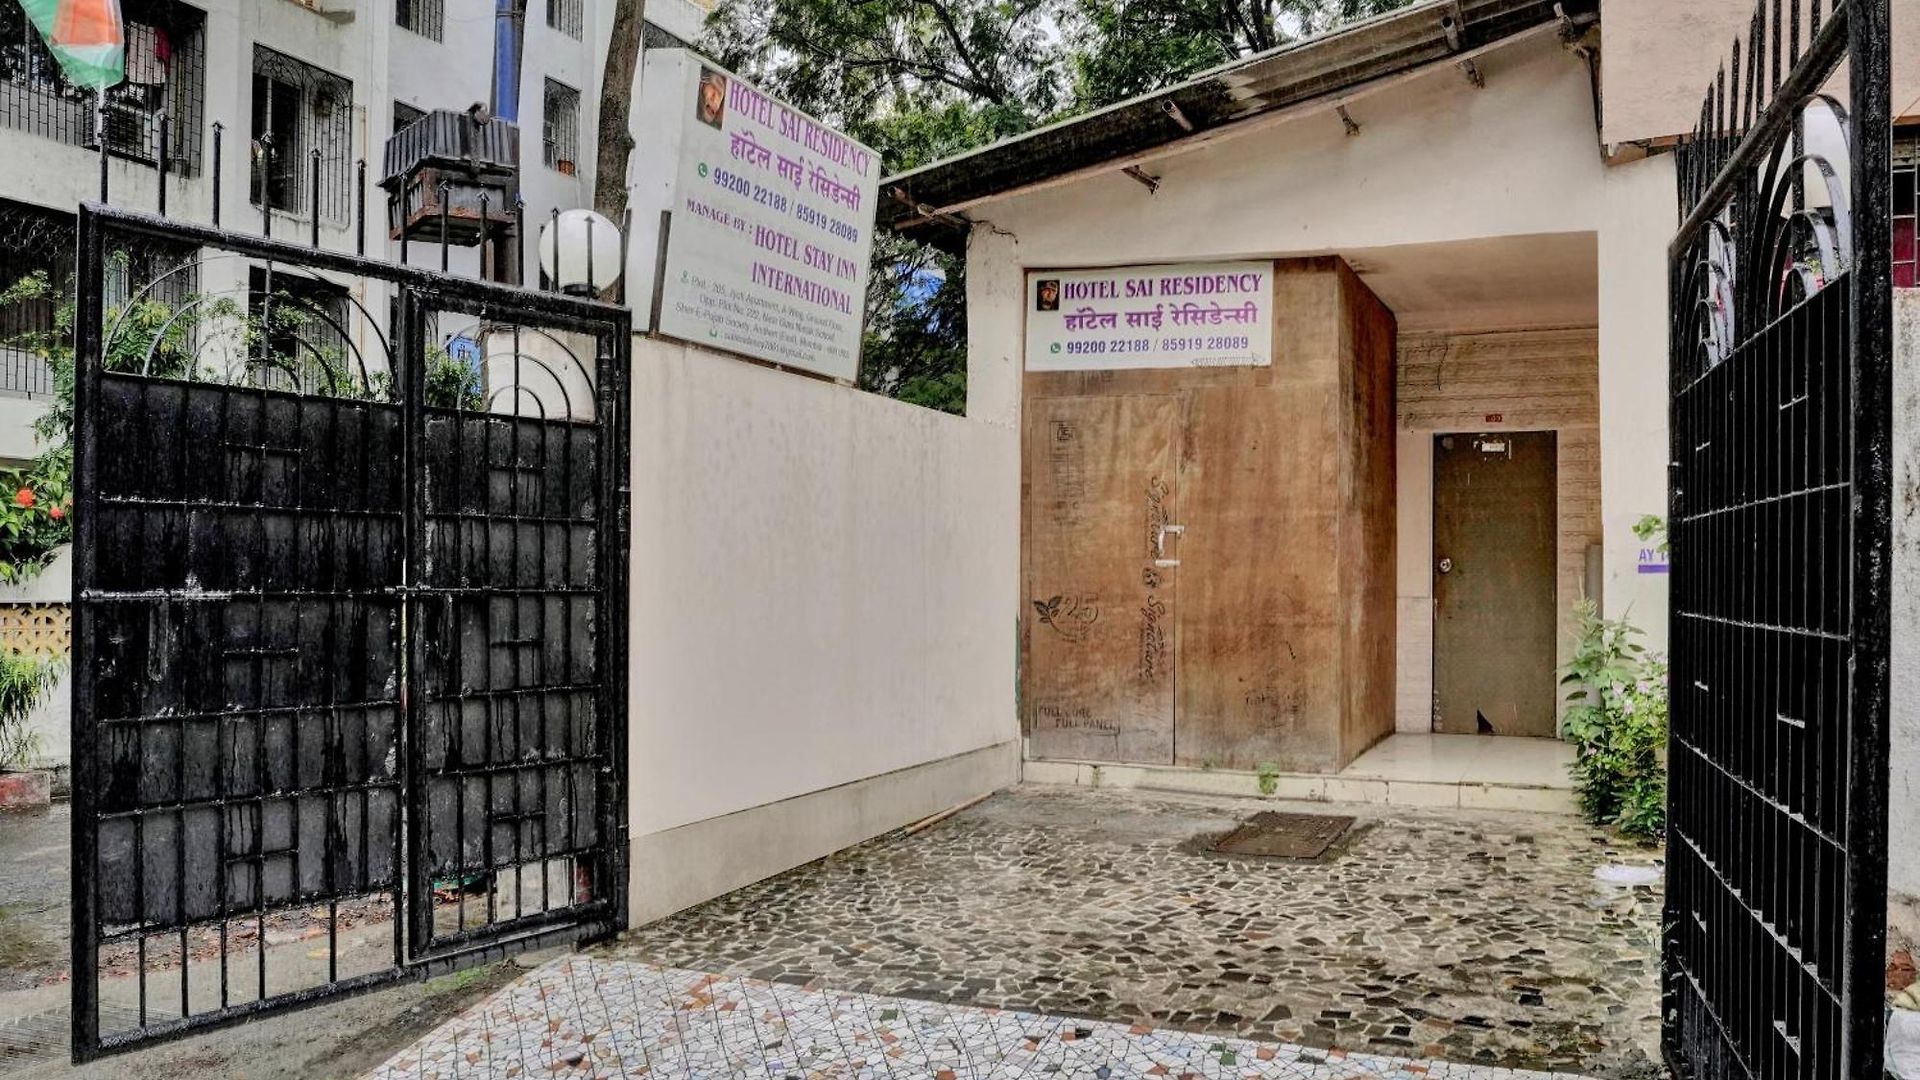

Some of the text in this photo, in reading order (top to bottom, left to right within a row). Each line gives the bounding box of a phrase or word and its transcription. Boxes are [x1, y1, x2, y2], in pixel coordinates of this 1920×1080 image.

[729, 80, 872, 178] HOTEL SAI RESIDENCY
[714, 167, 750, 198] 99200
[753, 185, 788, 213] 22188
[796, 203, 828, 230] 85919
[829, 219, 859, 243] 28089
[729, 128, 861, 212] हॉटेल साई रेसिडेन्सी
[686, 199, 731, 226] MANAGE
[755, 225, 801, 262] HOTEL
[803, 243, 834, 274] STAY
[836, 256, 858, 284] INN
[751, 261, 853, 316] INTERNATIONAL
[1063, 273, 1262, 300] HOTEL SAI RESIDENCY
[1063, 300, 1259, 332] हॉटेल साई रेसिडेन्सी
[1066, 340, 1106, 354] 99200
[1110, 339, 1150, 353] 22188
[1162, 338, 1202, 351] 85919
[1207, 336, 1249, 350] 28089
[1141, 595, 1166, 680] Signature
